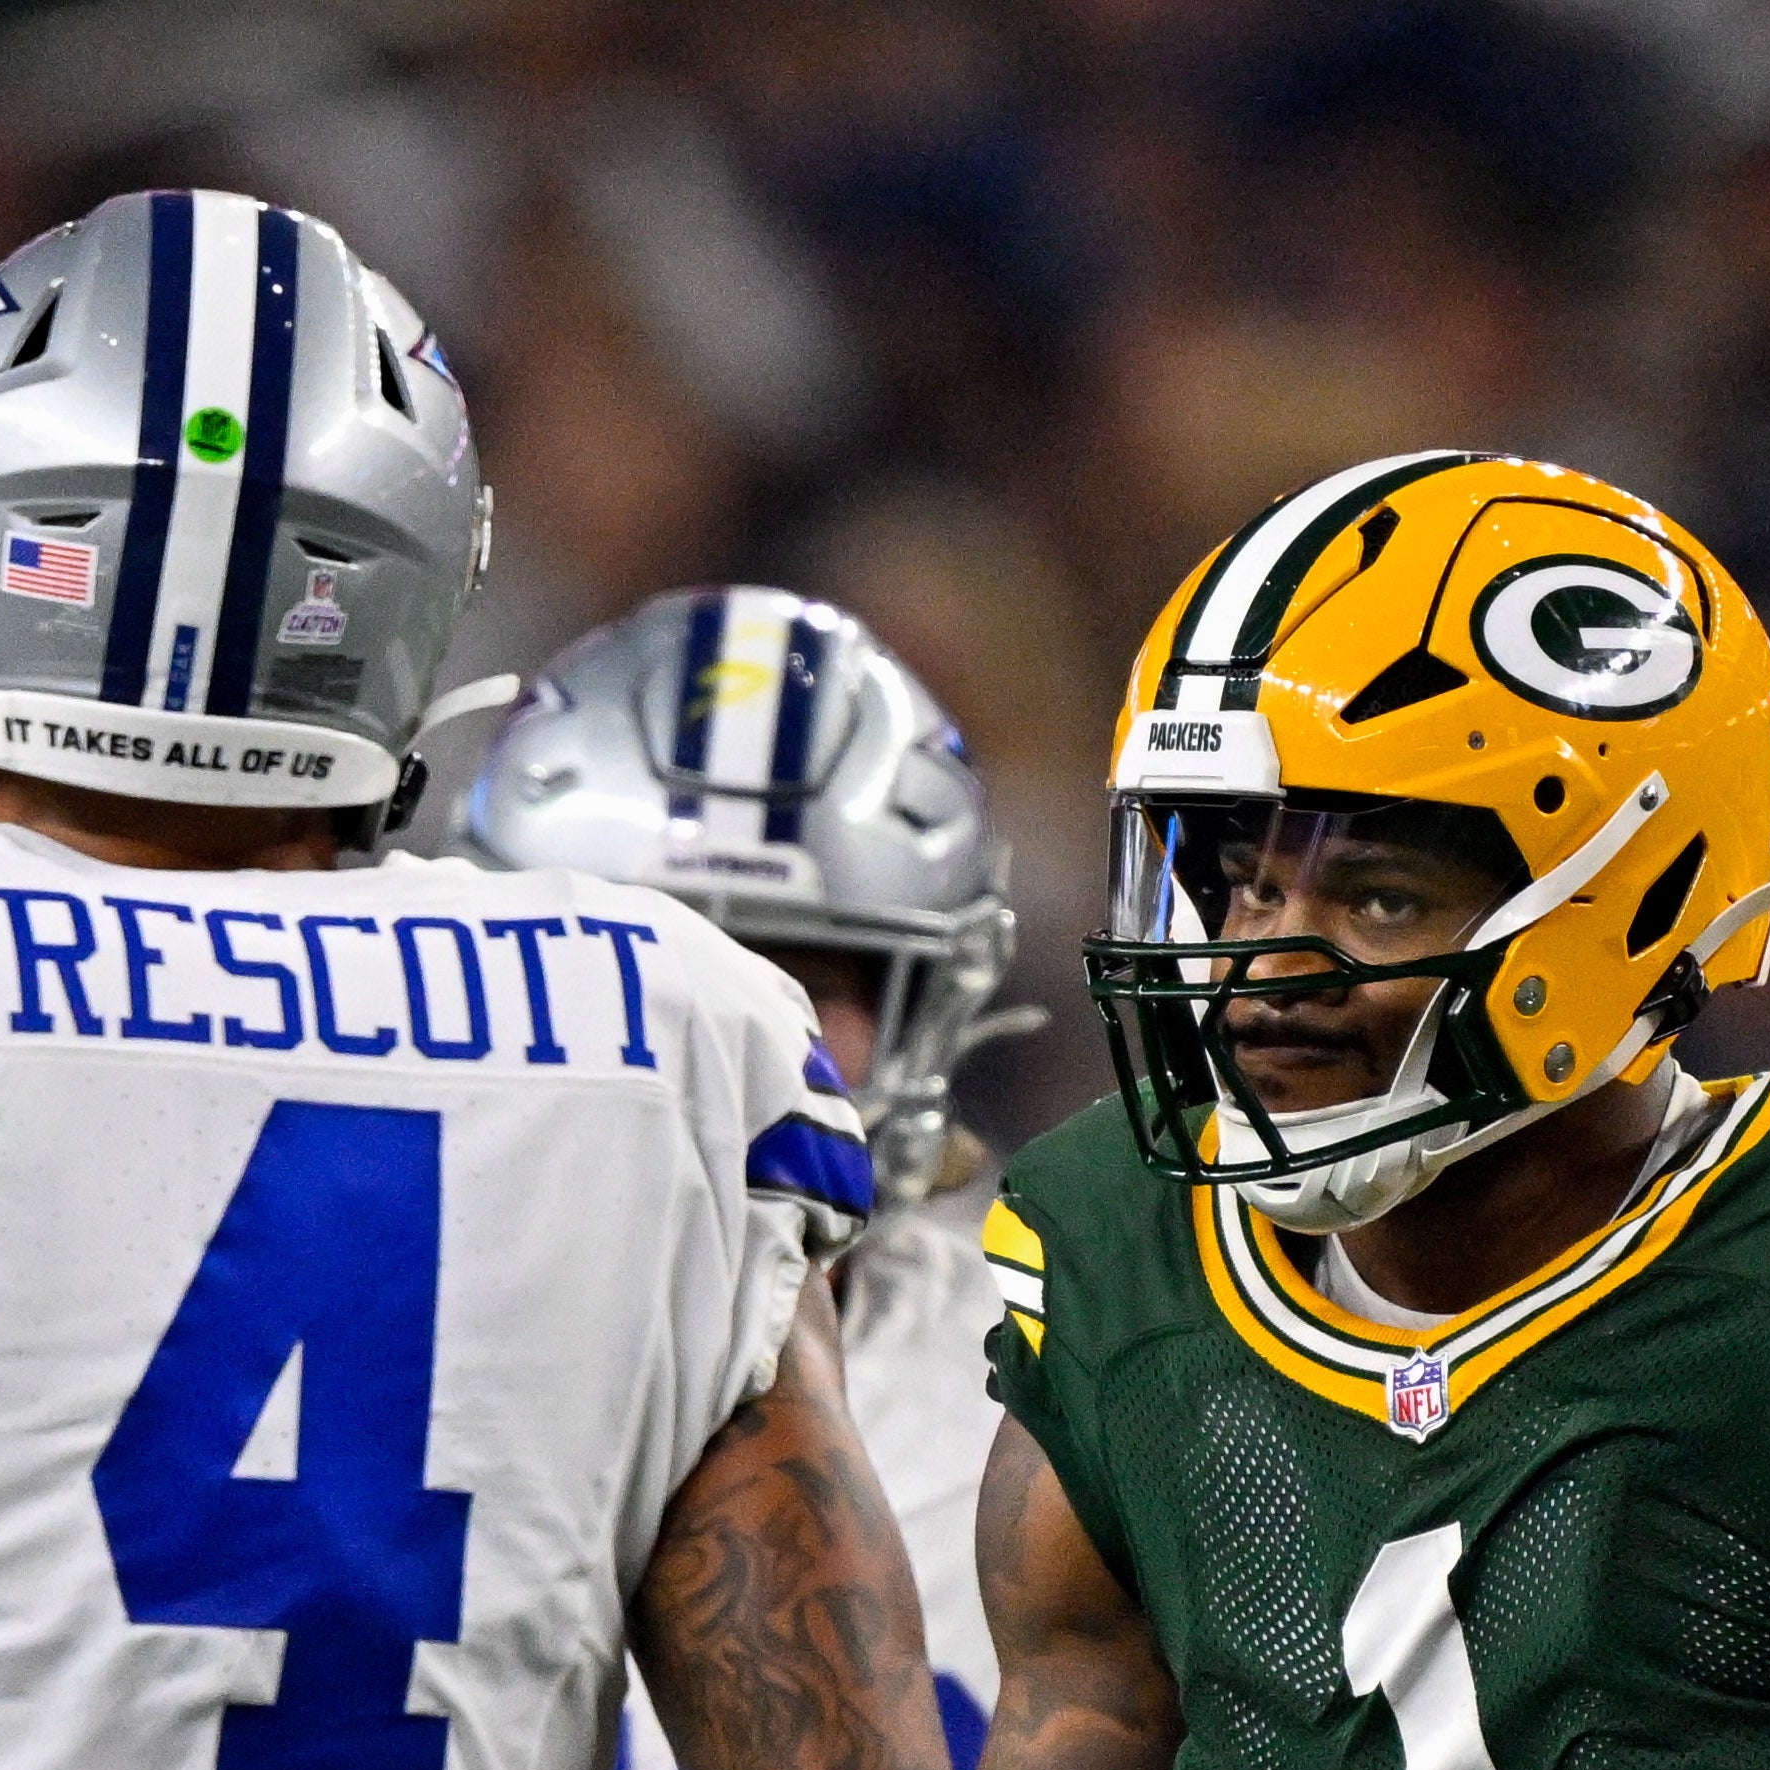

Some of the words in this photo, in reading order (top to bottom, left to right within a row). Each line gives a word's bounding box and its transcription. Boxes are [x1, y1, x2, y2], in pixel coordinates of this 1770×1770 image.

[1485, 564, 1695, 708] G
[3, 717, 32, 743] IT
[44, 722, 153, 761] TAKES
[164, 741, 229, 771] ALL
[239, 748, 285, 775] OF
[290, 752, 335, 780] US
[1147, 722, 1223, 752] PACKERS
[1396, 1387, 1441, 1425] NFL
